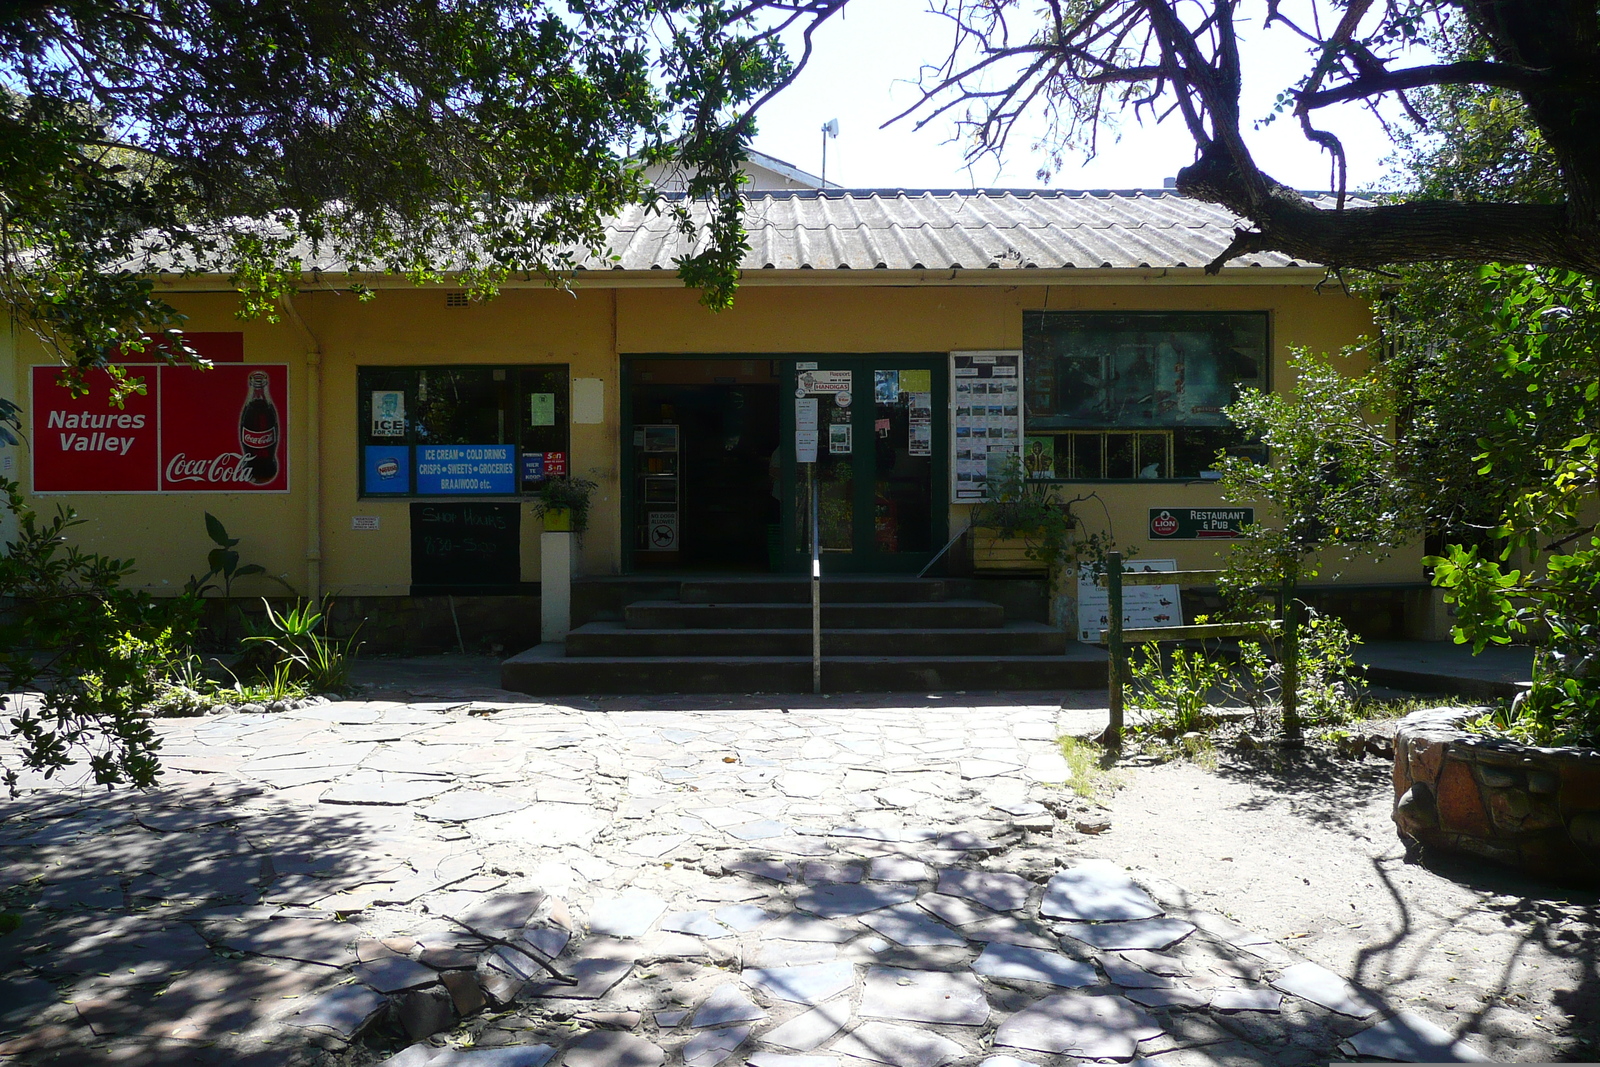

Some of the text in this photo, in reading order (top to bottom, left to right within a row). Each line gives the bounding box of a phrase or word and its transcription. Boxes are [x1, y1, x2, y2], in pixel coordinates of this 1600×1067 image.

[48, 411, 146, 429] Natures
[374, 420, 403, 430] ICE
[60, 432, 135, 456] Valley
[425, 449, 506, 460] ICE CREAM COLD DRINKS
[166, 452, 258, 483] Coca-Cola
[419, 463, 513, 475] CRISPS SWEETS GROCERIES
[440, 478, 479, 490] BRAAIWOOD
